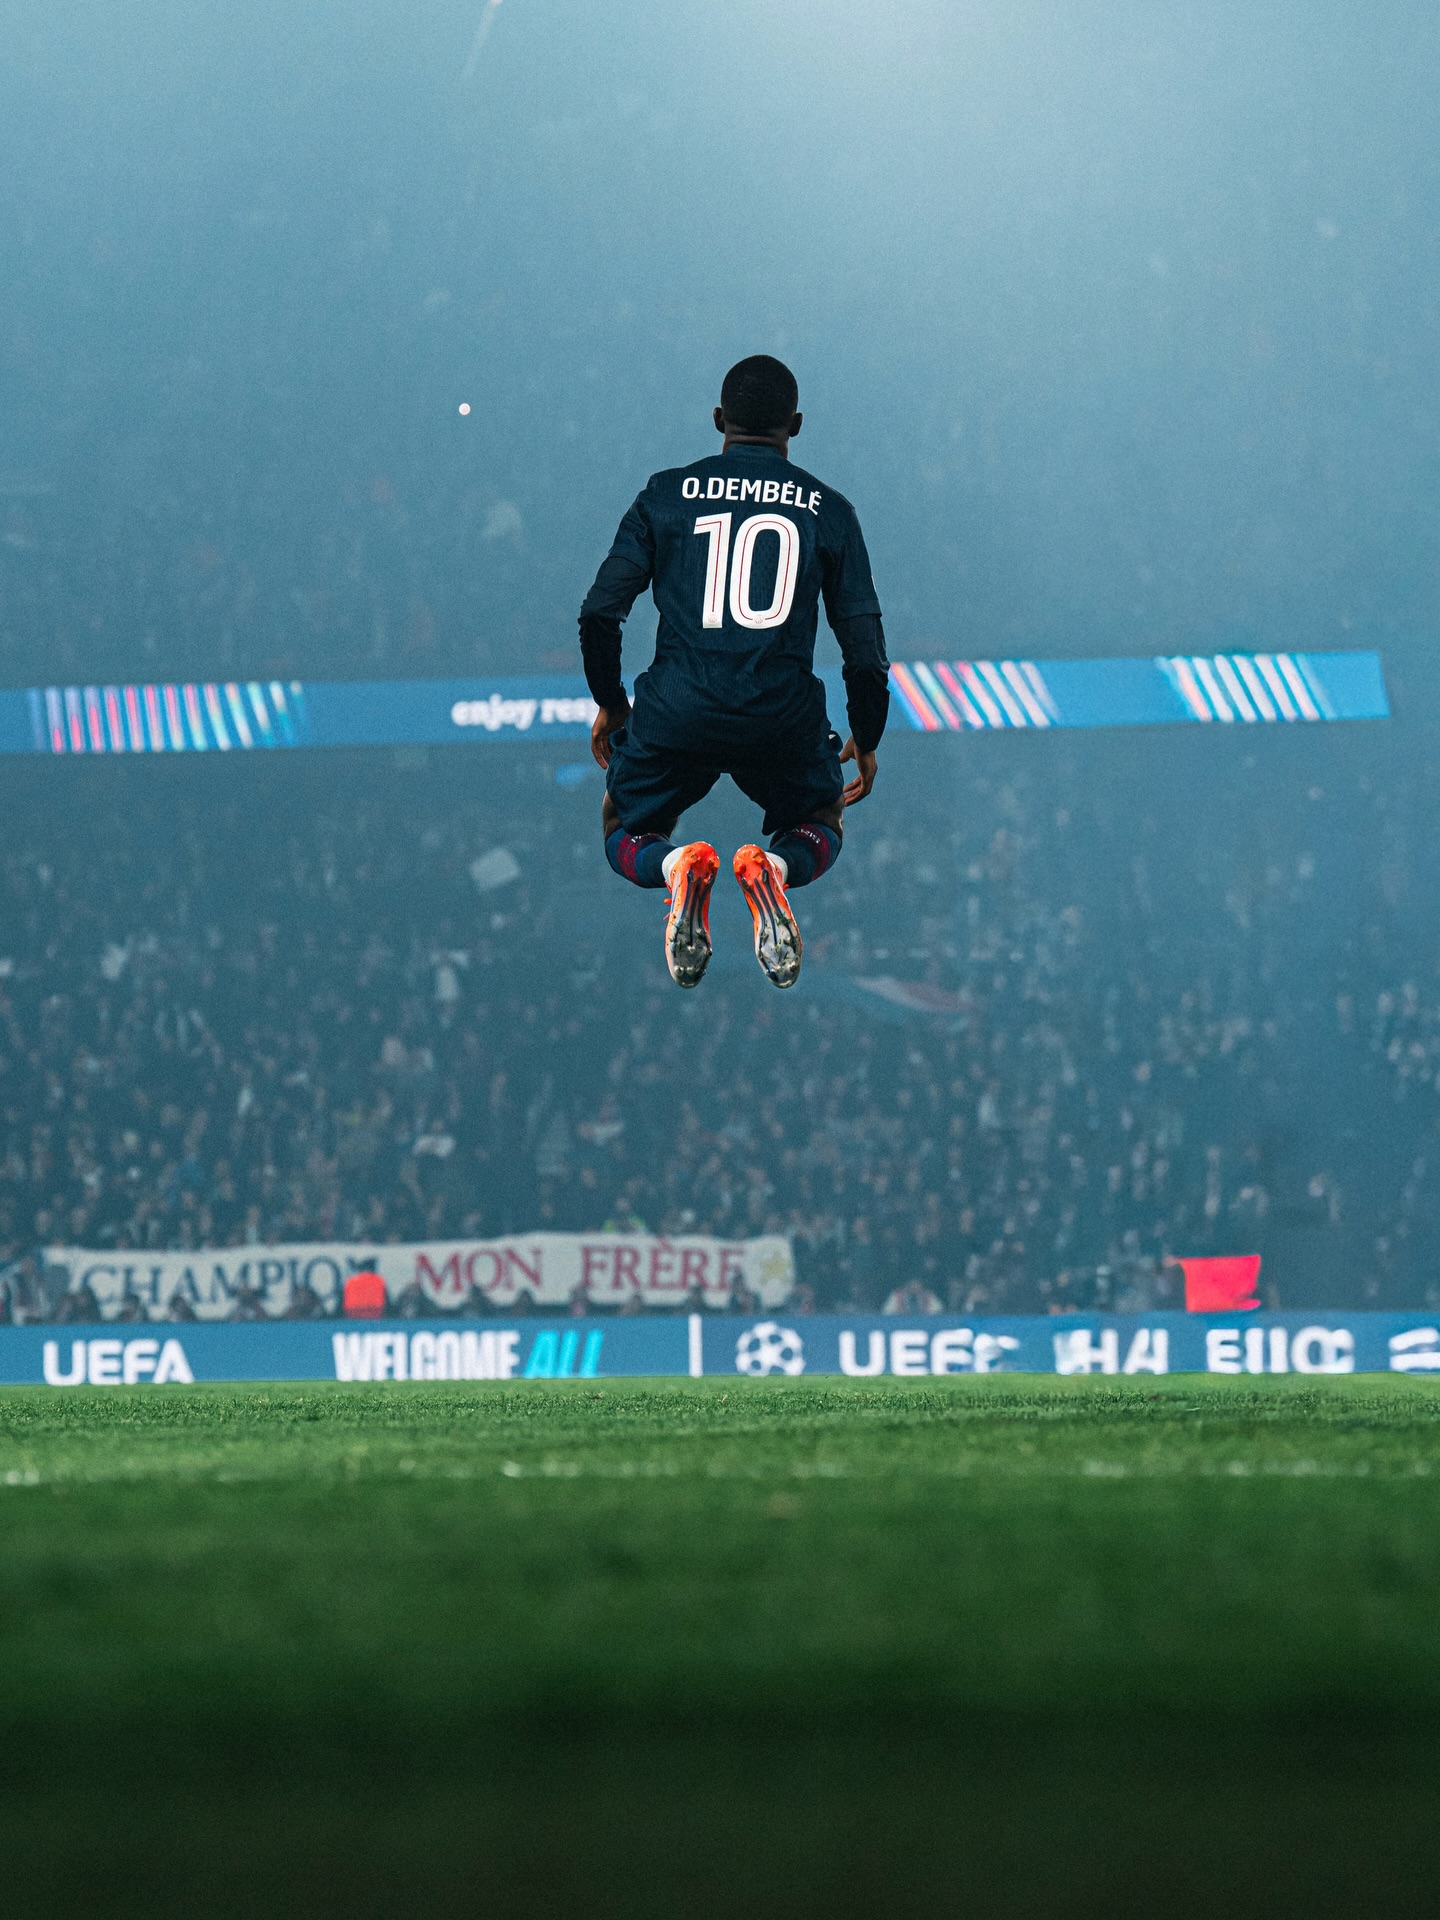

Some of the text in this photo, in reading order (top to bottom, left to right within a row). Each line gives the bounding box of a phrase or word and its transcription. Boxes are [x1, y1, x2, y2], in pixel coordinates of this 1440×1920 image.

[682, 477, 822, 516] O.DEMBÉLÉ
[693, 512, 800, 629] 10
[452, 693, 537, 731] enjoy
[415, 1247, 543, 1292] MON
[43, 1338, 195, 1385] UEFA
